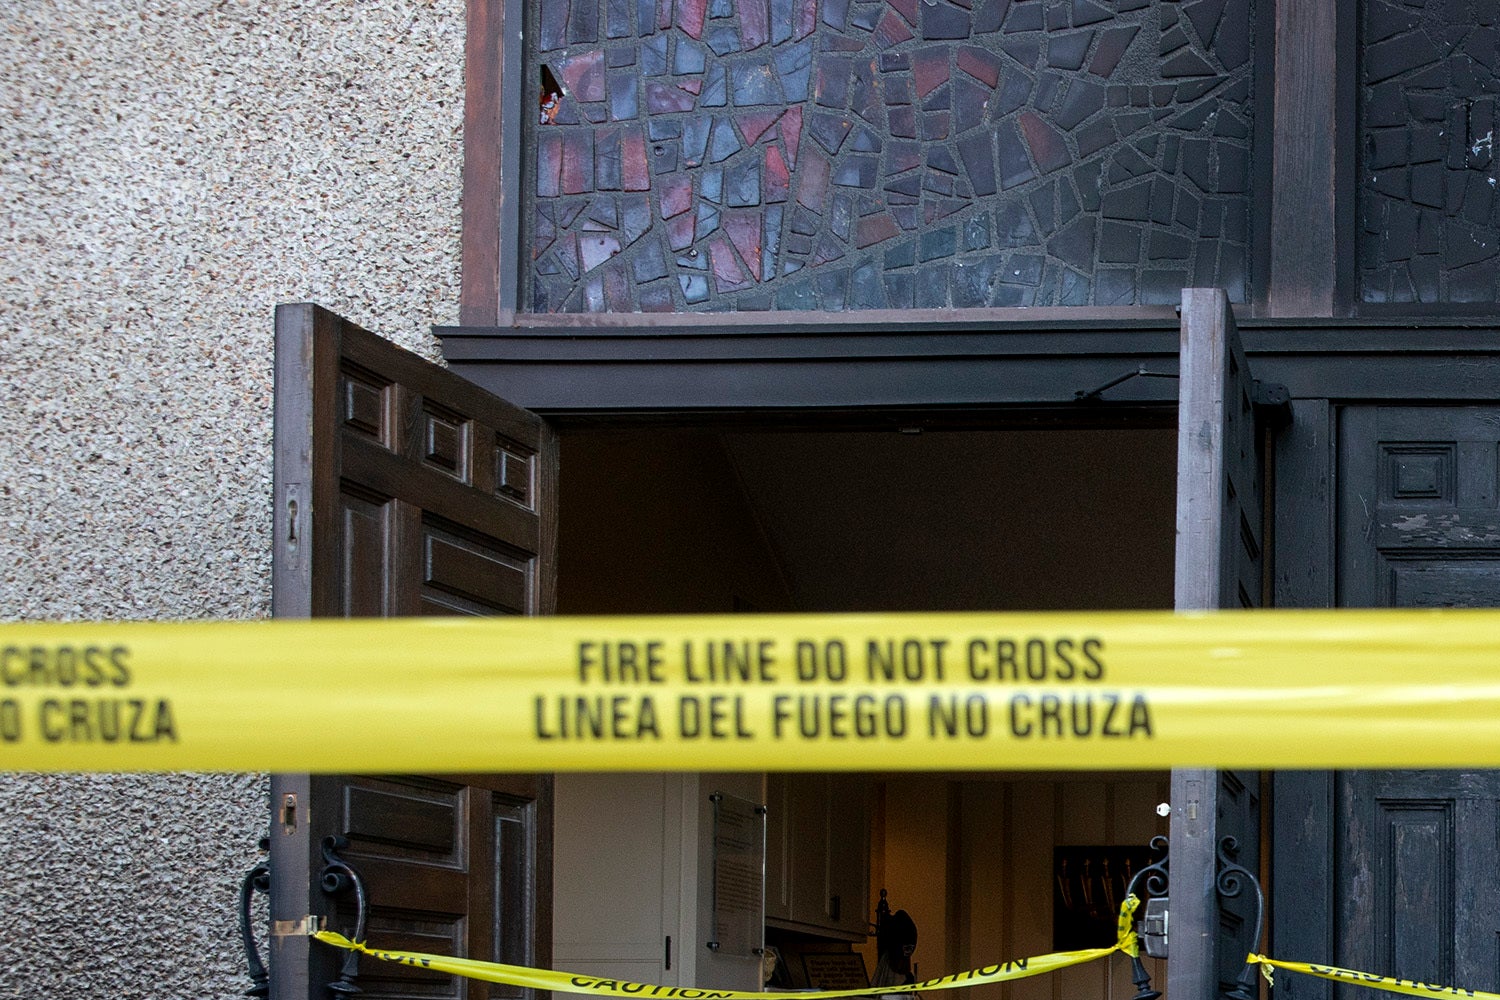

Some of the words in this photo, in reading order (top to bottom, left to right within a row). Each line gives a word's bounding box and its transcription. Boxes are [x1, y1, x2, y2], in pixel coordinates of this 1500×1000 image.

[2, 645, 132, 687] CROSS
[577, 638, 665, 684] FIRE
[683, 638, 778, 684] LINE
[795, 638, 848, 684] DO
[866, 638, 948, 684] NOT
[967, 638, 1106, 684] CROSS
[41, 697, 178, 742] CRUZA
[534, 694, 660, 740] LINEA
[679, 694, 754, 740] DEL
[773, 694, 909, 740] FUEGO
[928, 694, 988, 740] NO
[1008, 694, 1154, 740] CRUZA
